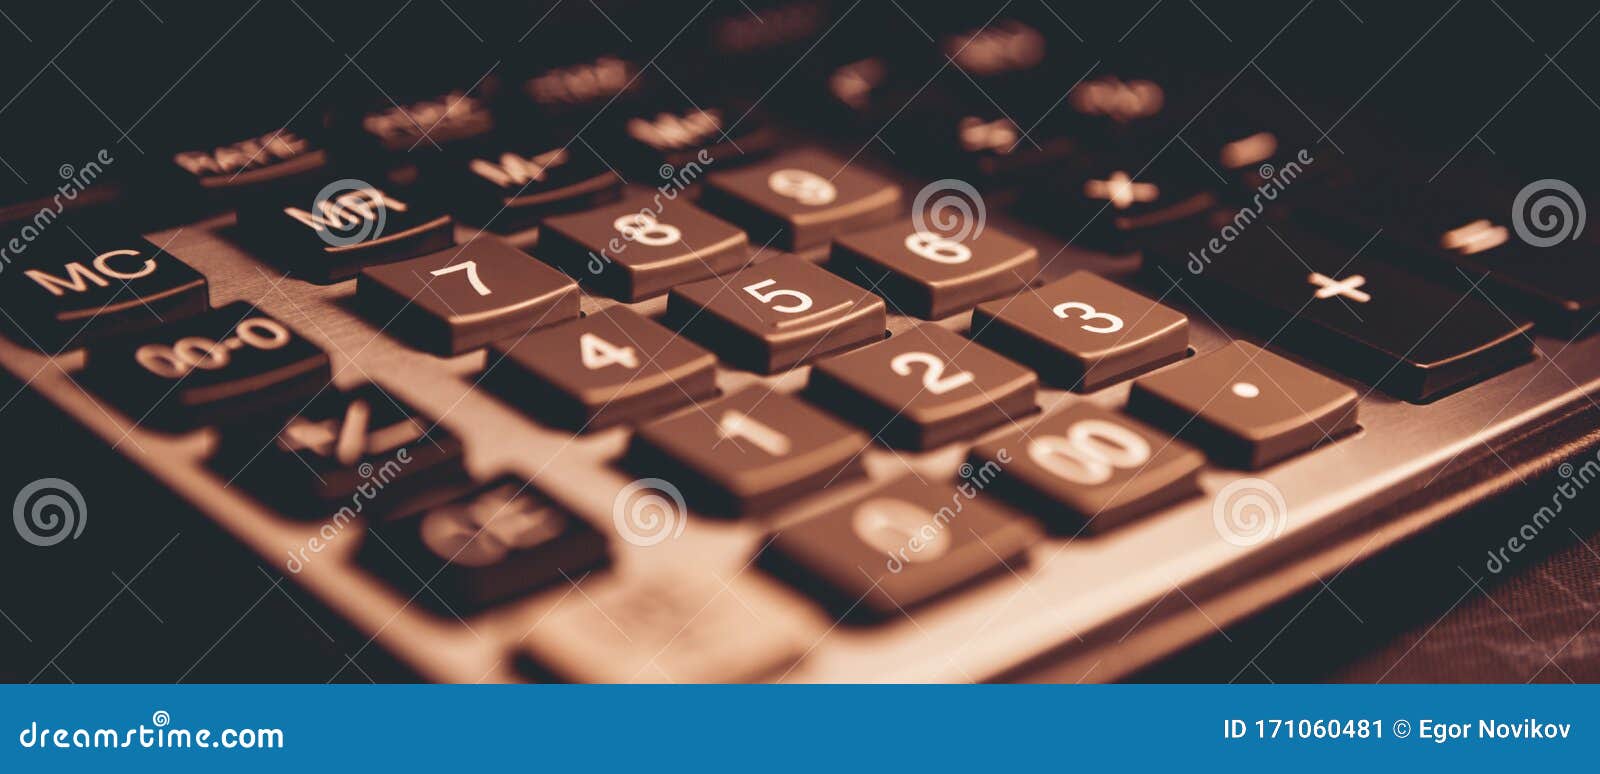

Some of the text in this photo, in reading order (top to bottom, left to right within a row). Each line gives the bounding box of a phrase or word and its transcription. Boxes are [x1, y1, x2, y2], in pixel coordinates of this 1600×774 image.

[284, 188, 407, 231] MR
[613, 213, 681, 246] 8
[905, 231, 972, 264] 6
[23, 249, 157, 296] MC
[430, 260, 491, 296] 7
[743, 278, 813, 313] 5
[1053, 301, 1124, 334] 3
[580, 333, 640, 370] 4
[891, 351, 975, 393] 2
[717, 409, 791, 456] 1
[1028, 419, 1151, 485] 00
[852, 497, 951, 562] 0
